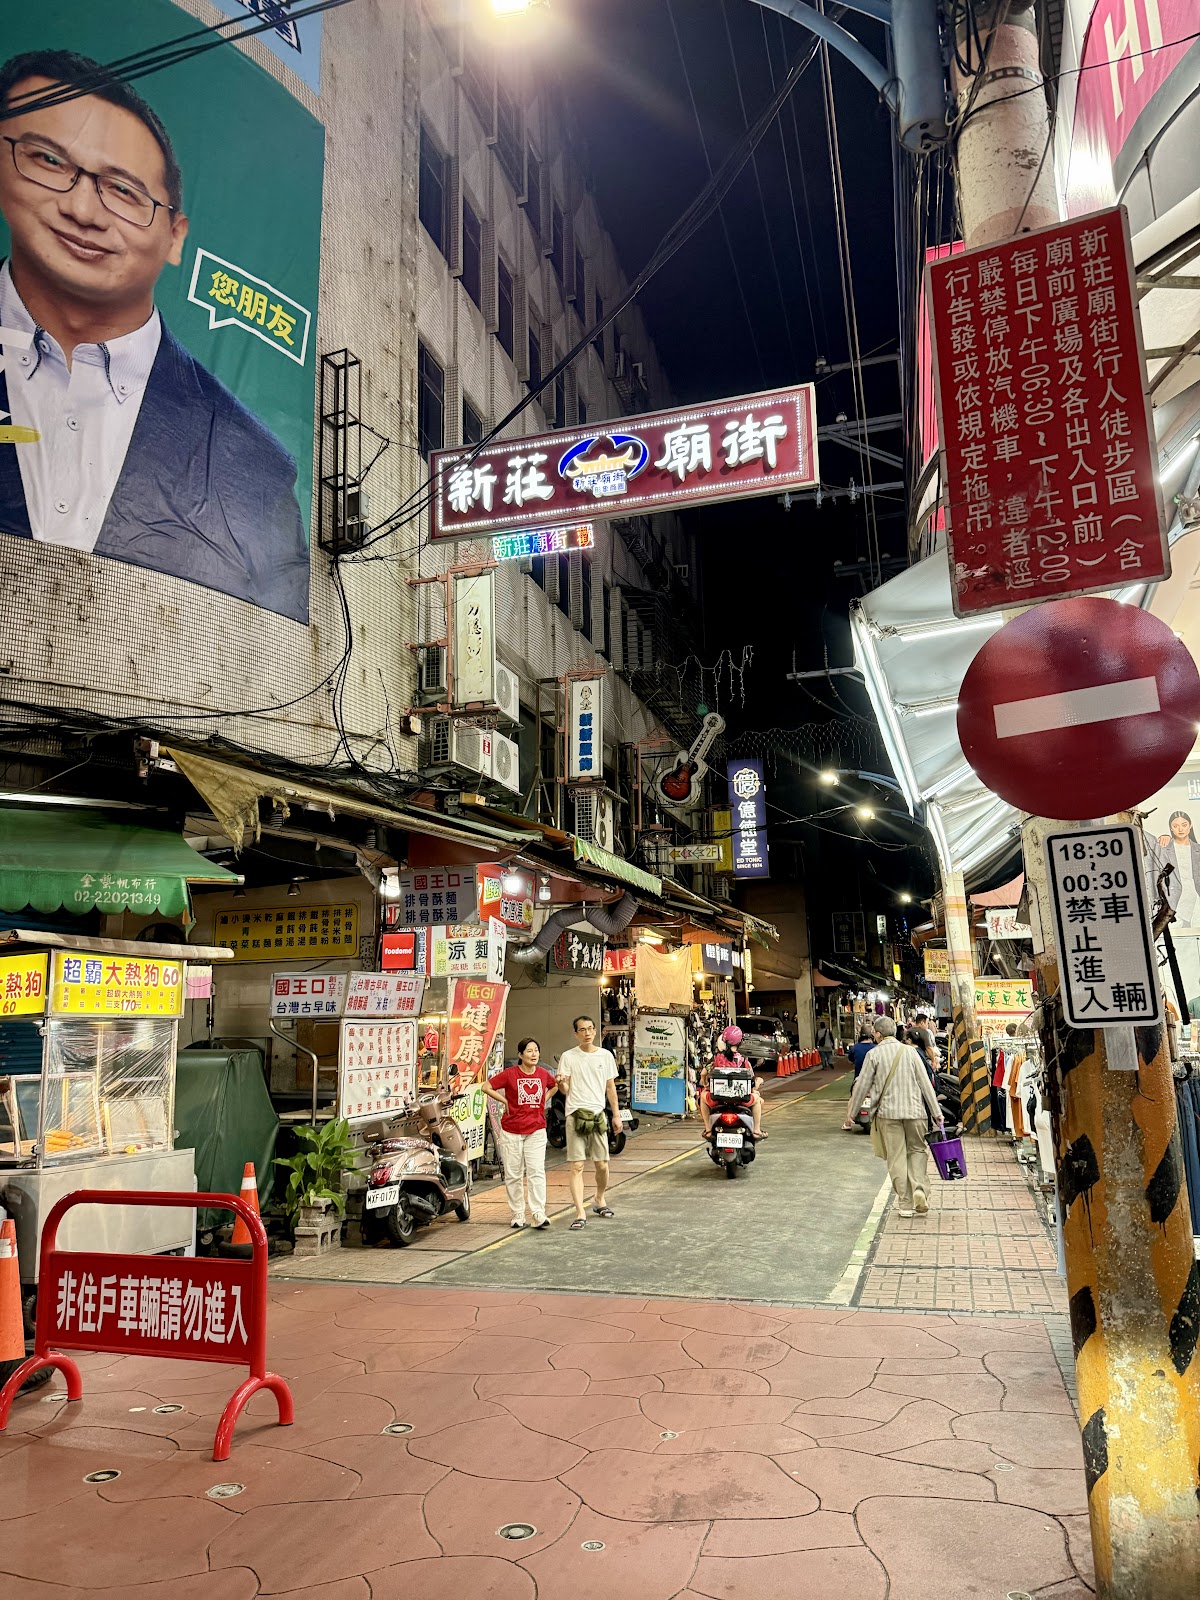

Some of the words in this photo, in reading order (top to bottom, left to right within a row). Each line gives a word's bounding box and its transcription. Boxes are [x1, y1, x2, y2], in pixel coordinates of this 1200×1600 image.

[208, 270, 297, 346] 您朋友
[447, 452, 555, 513] 新莊
[653, 413, 787, 482] 廟街
[573, 470, 627, 490] 新莊廟街
[493, 530, 568, 558] 新莊廟街
[738, 800, 758, 857] 億德堂
[1059, 838, 1123, 861] 18:30
[414, 873, 461, 891] 國王口
[1062, 870, 1128, 893] 00:30
[74, 891, 162, 905] 02-22021349
[404, 891, 457, 907] 排骨酥麵
[404, 907, 458, 923] 排骨酥湯
[332, 909, 342, 945] 排骨米粉
[344, 908, 353, 944] 排骨麵
[384, 947, 413, 955] foodomo
[1066, 896, 1110, 1013] 禁止進入
[63, 957, 160, 988] 超霸大熱狗
[163, 968, 180, 987] 60
[275, 978, 325, 996] 國王口
[357, 979, 388, 991] 台灣古早味
[466, 984, 495, 1000] 低GI
[2, 1000, 16, 1014] 60
[276, 1001, 337, 1014] 台灣古早味
[56, 1270, 249, 1345] 非住戶車輛請勿進入
